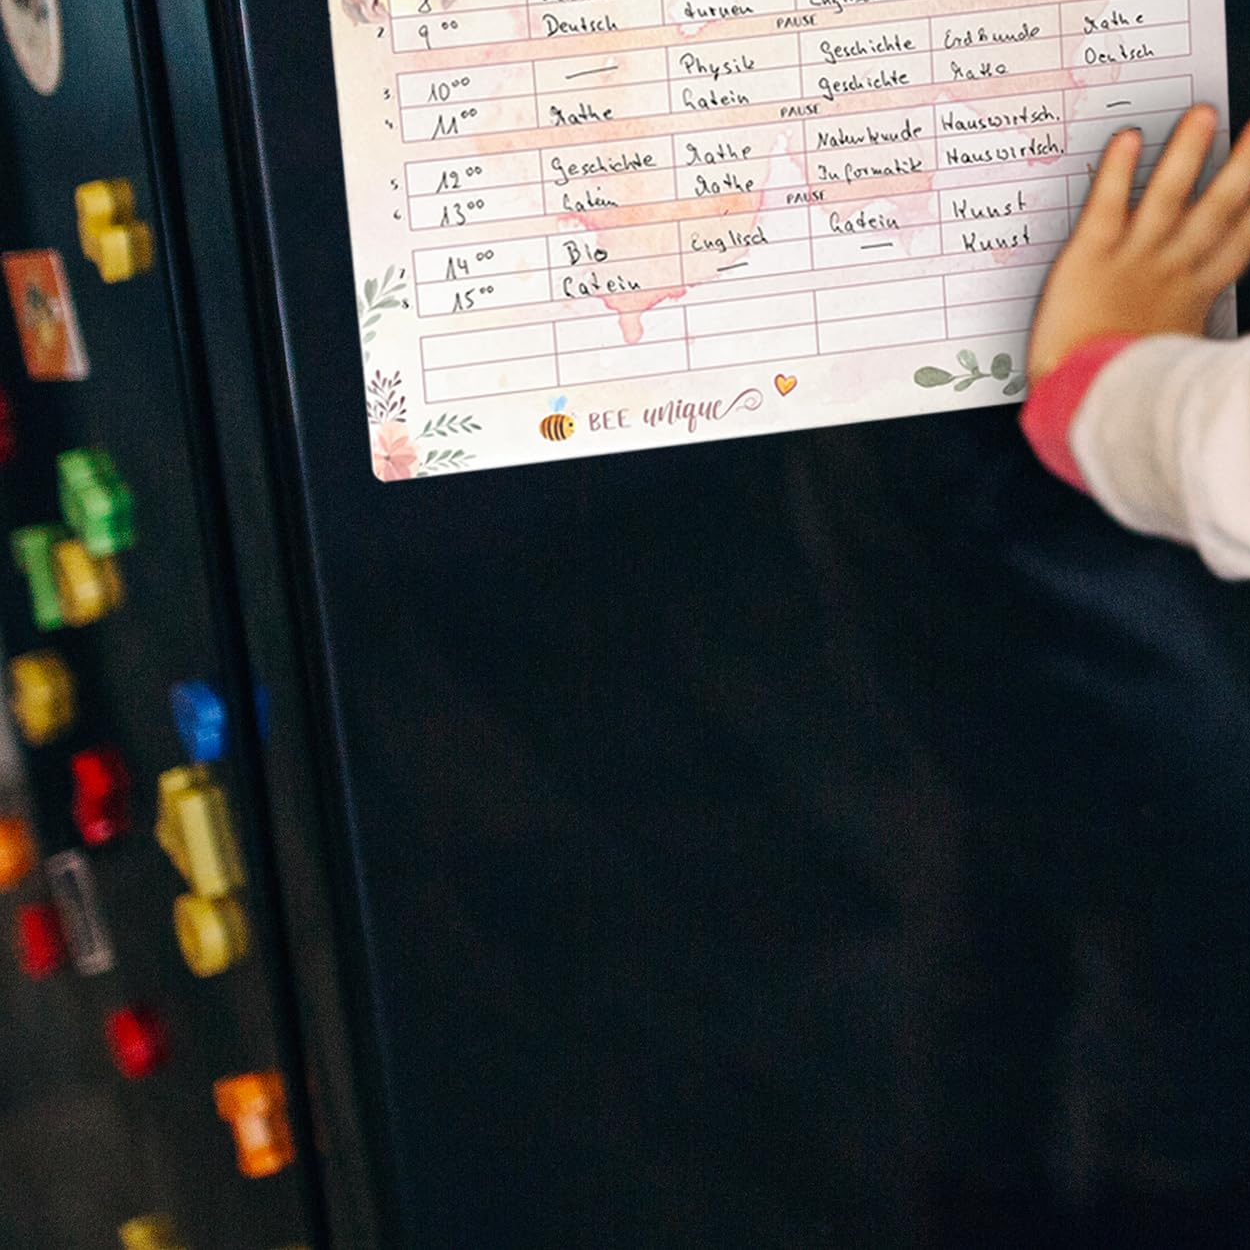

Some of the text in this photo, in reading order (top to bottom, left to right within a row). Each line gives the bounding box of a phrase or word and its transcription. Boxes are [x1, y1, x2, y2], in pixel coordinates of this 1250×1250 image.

[542, 14, 618, 37] Deutsch
[776, 15, 818, 28] PAUSE
[820, 34, 916, 65] Geschichte
[817, 70, 910, 101] Geschichte
[780, 104, 822, 118] PAUSE
[785, 190, 827, 204] PAUSE
[952, 190, 1028, 219] Kunst
[962, 224, 1030, 252] Kunst
[562, 240, 609, 266] Bio
[588, 388, 763, 434] BEE unique
